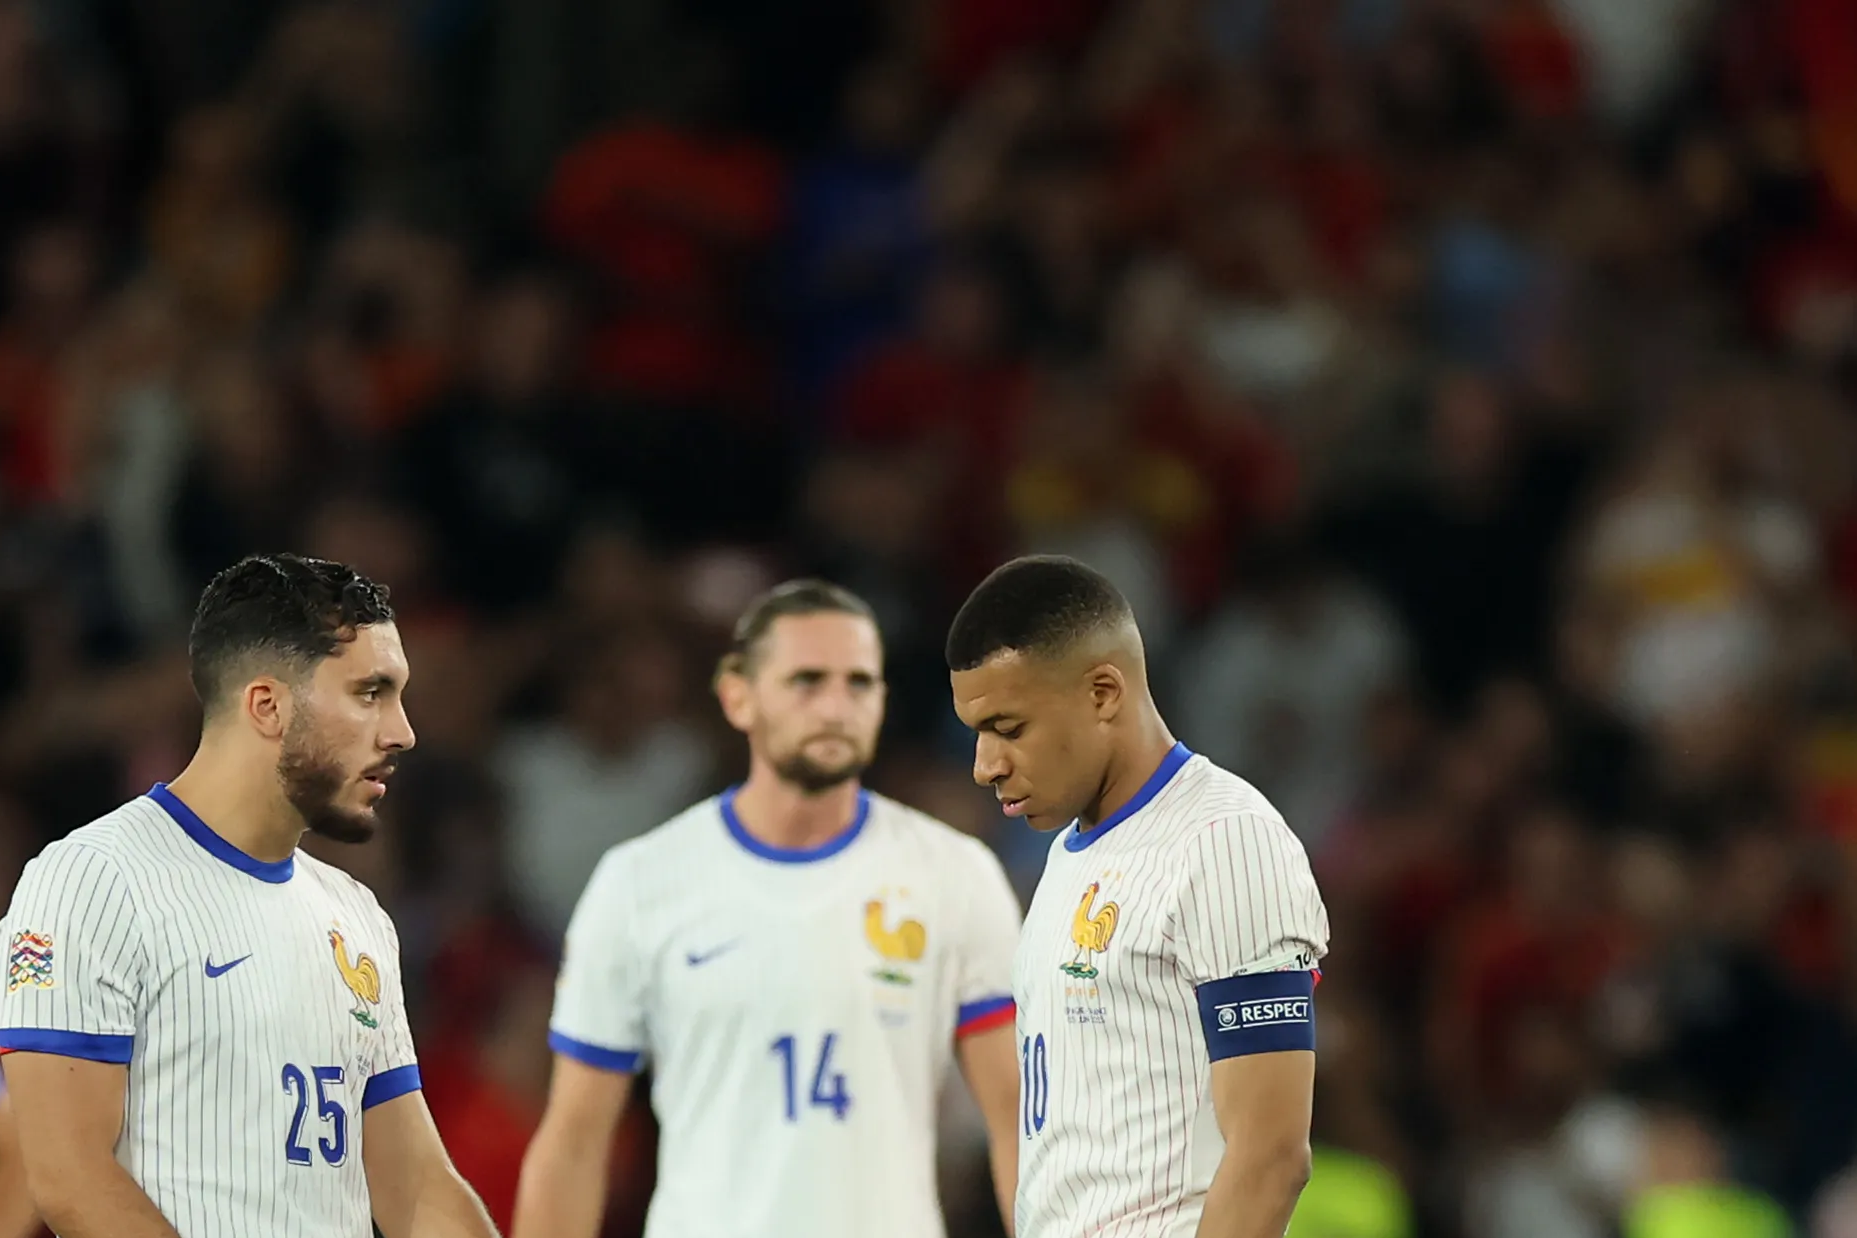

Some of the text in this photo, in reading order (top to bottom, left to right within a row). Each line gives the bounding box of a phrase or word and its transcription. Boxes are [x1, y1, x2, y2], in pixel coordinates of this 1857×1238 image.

[1241, 1002, 1309, 1022] RESPECT
[281, 1062, 347, 1168] 25
[768, 1031, 854, 1123] 14
[1023, 1032, 1048, 1140] 10
